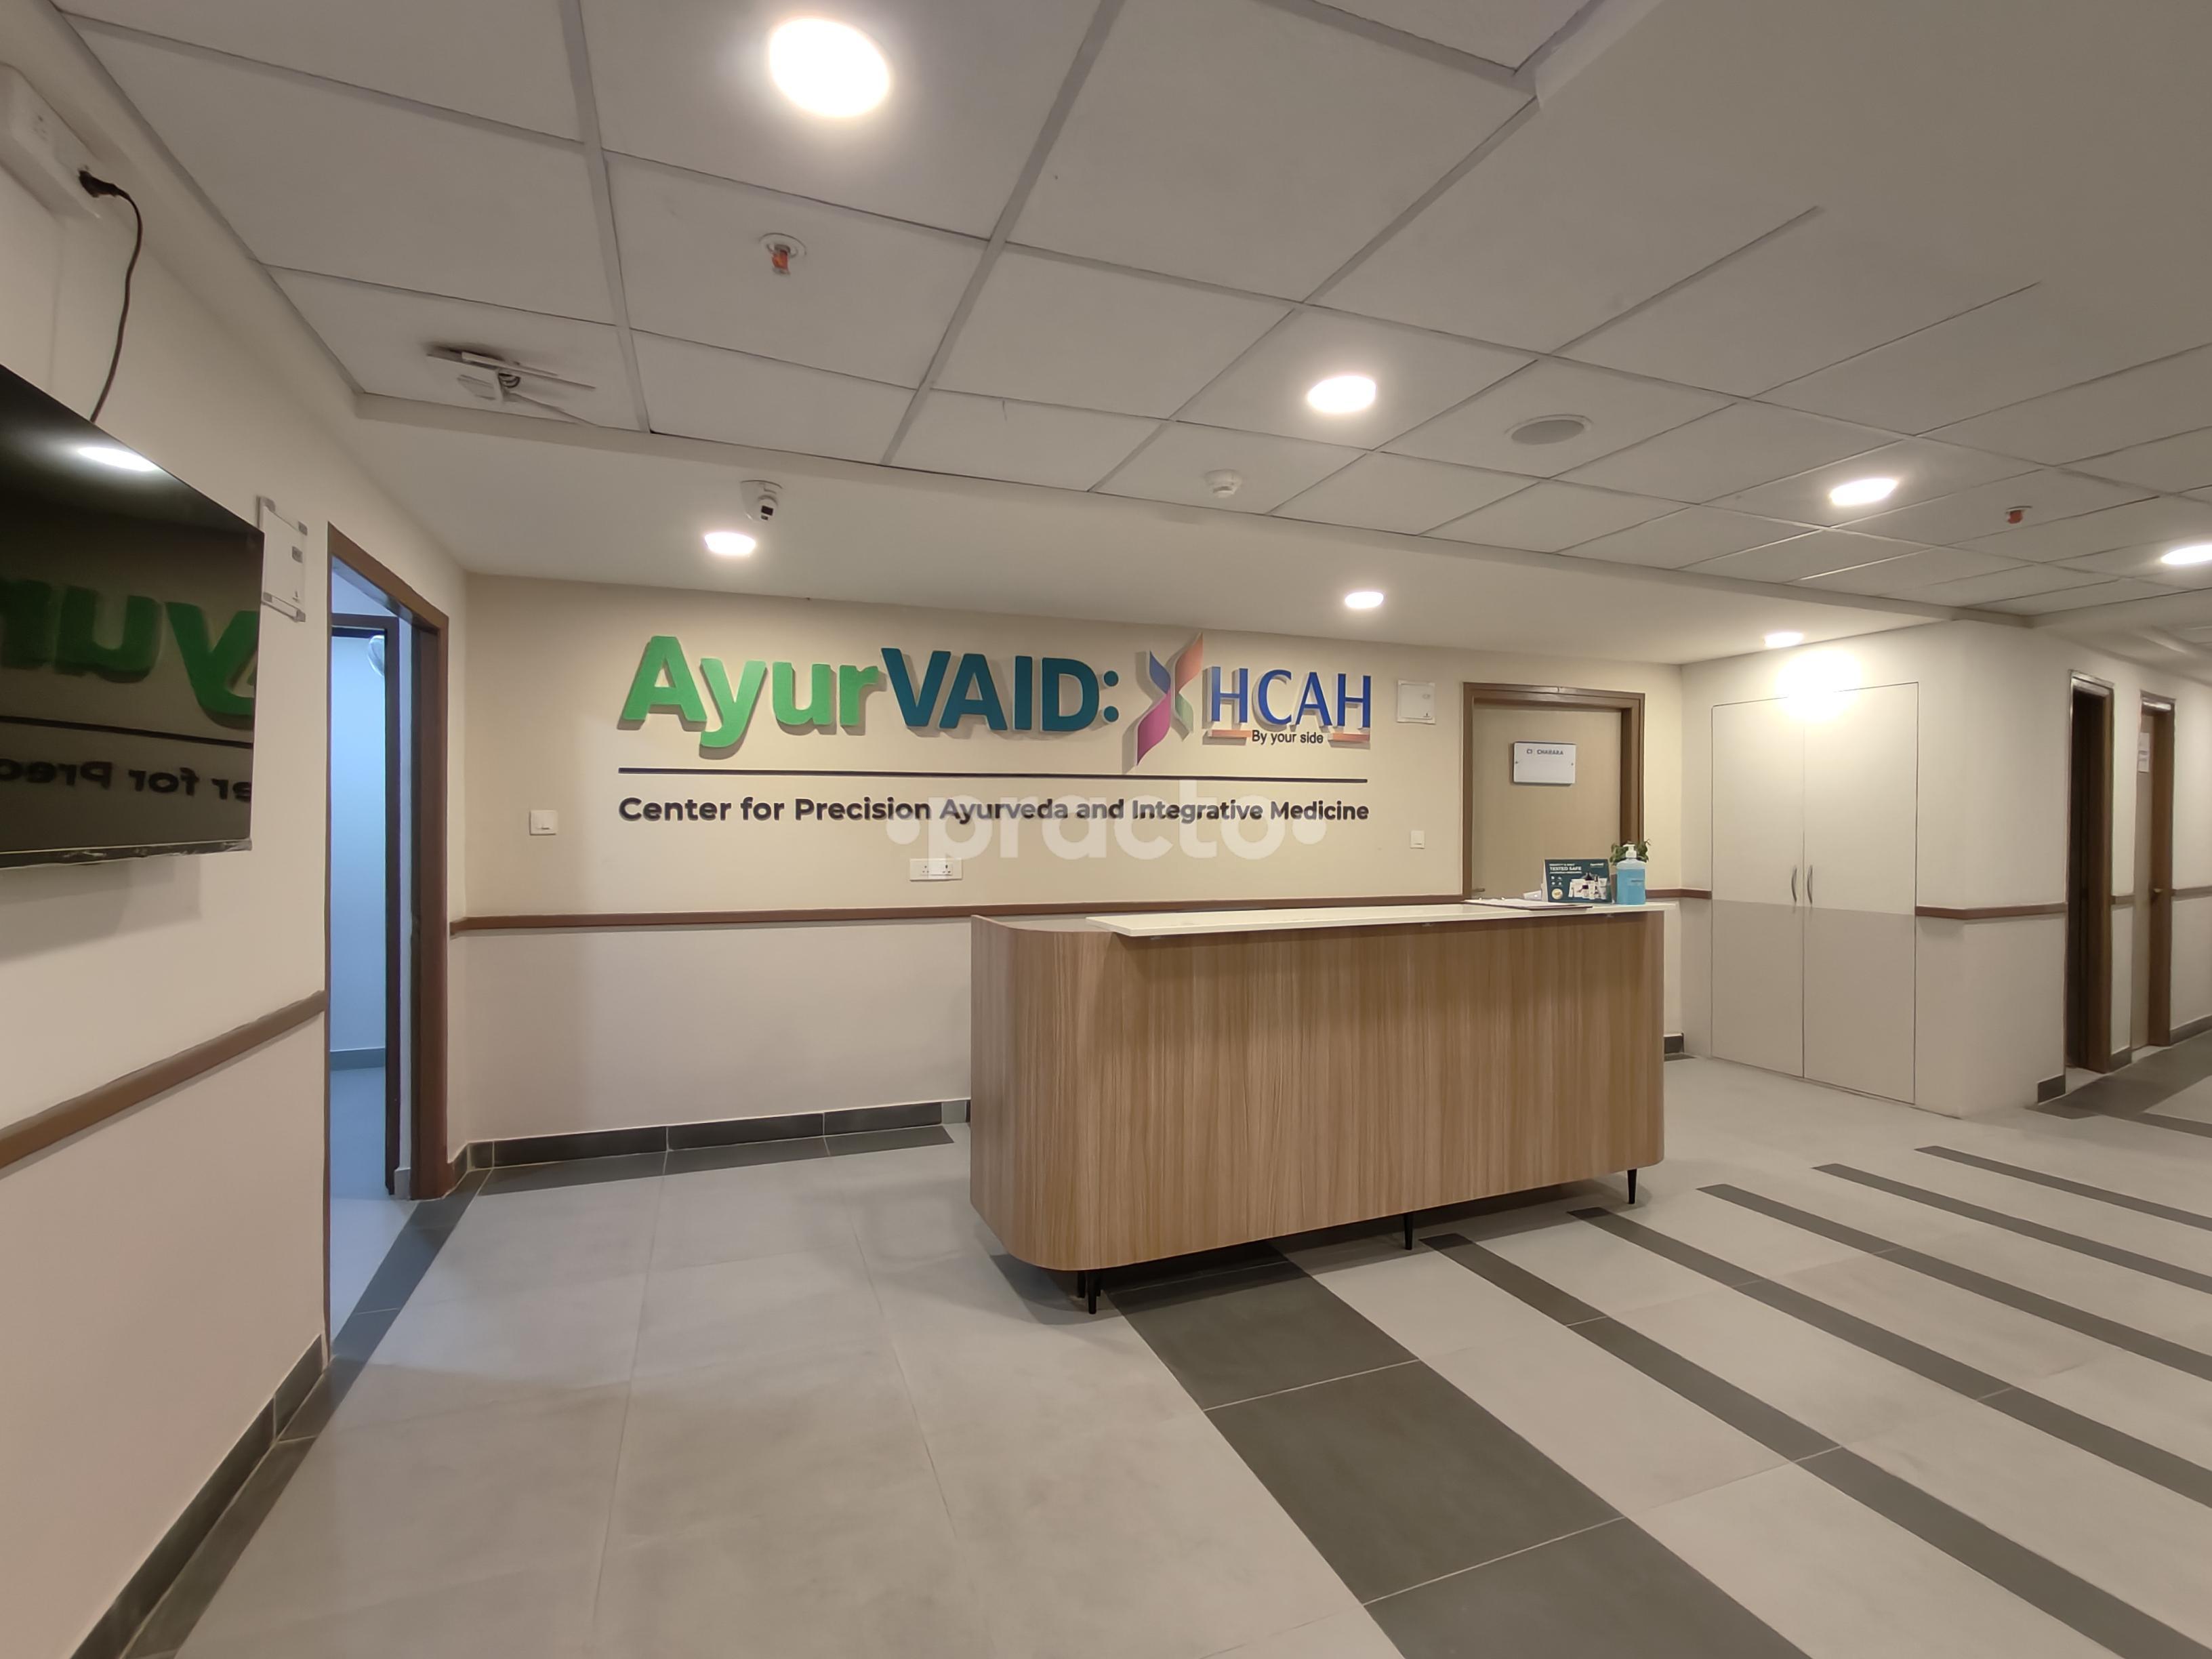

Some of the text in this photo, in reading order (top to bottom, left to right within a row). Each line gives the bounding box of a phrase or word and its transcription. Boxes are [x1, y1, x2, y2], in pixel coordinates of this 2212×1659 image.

[1210, 666, 1372, 728] HCAH
[1252, 729, 1324, 745] By your side
[618, 796, 1370, 825] Center for Precision Ayurveda and Integrative Medicine
